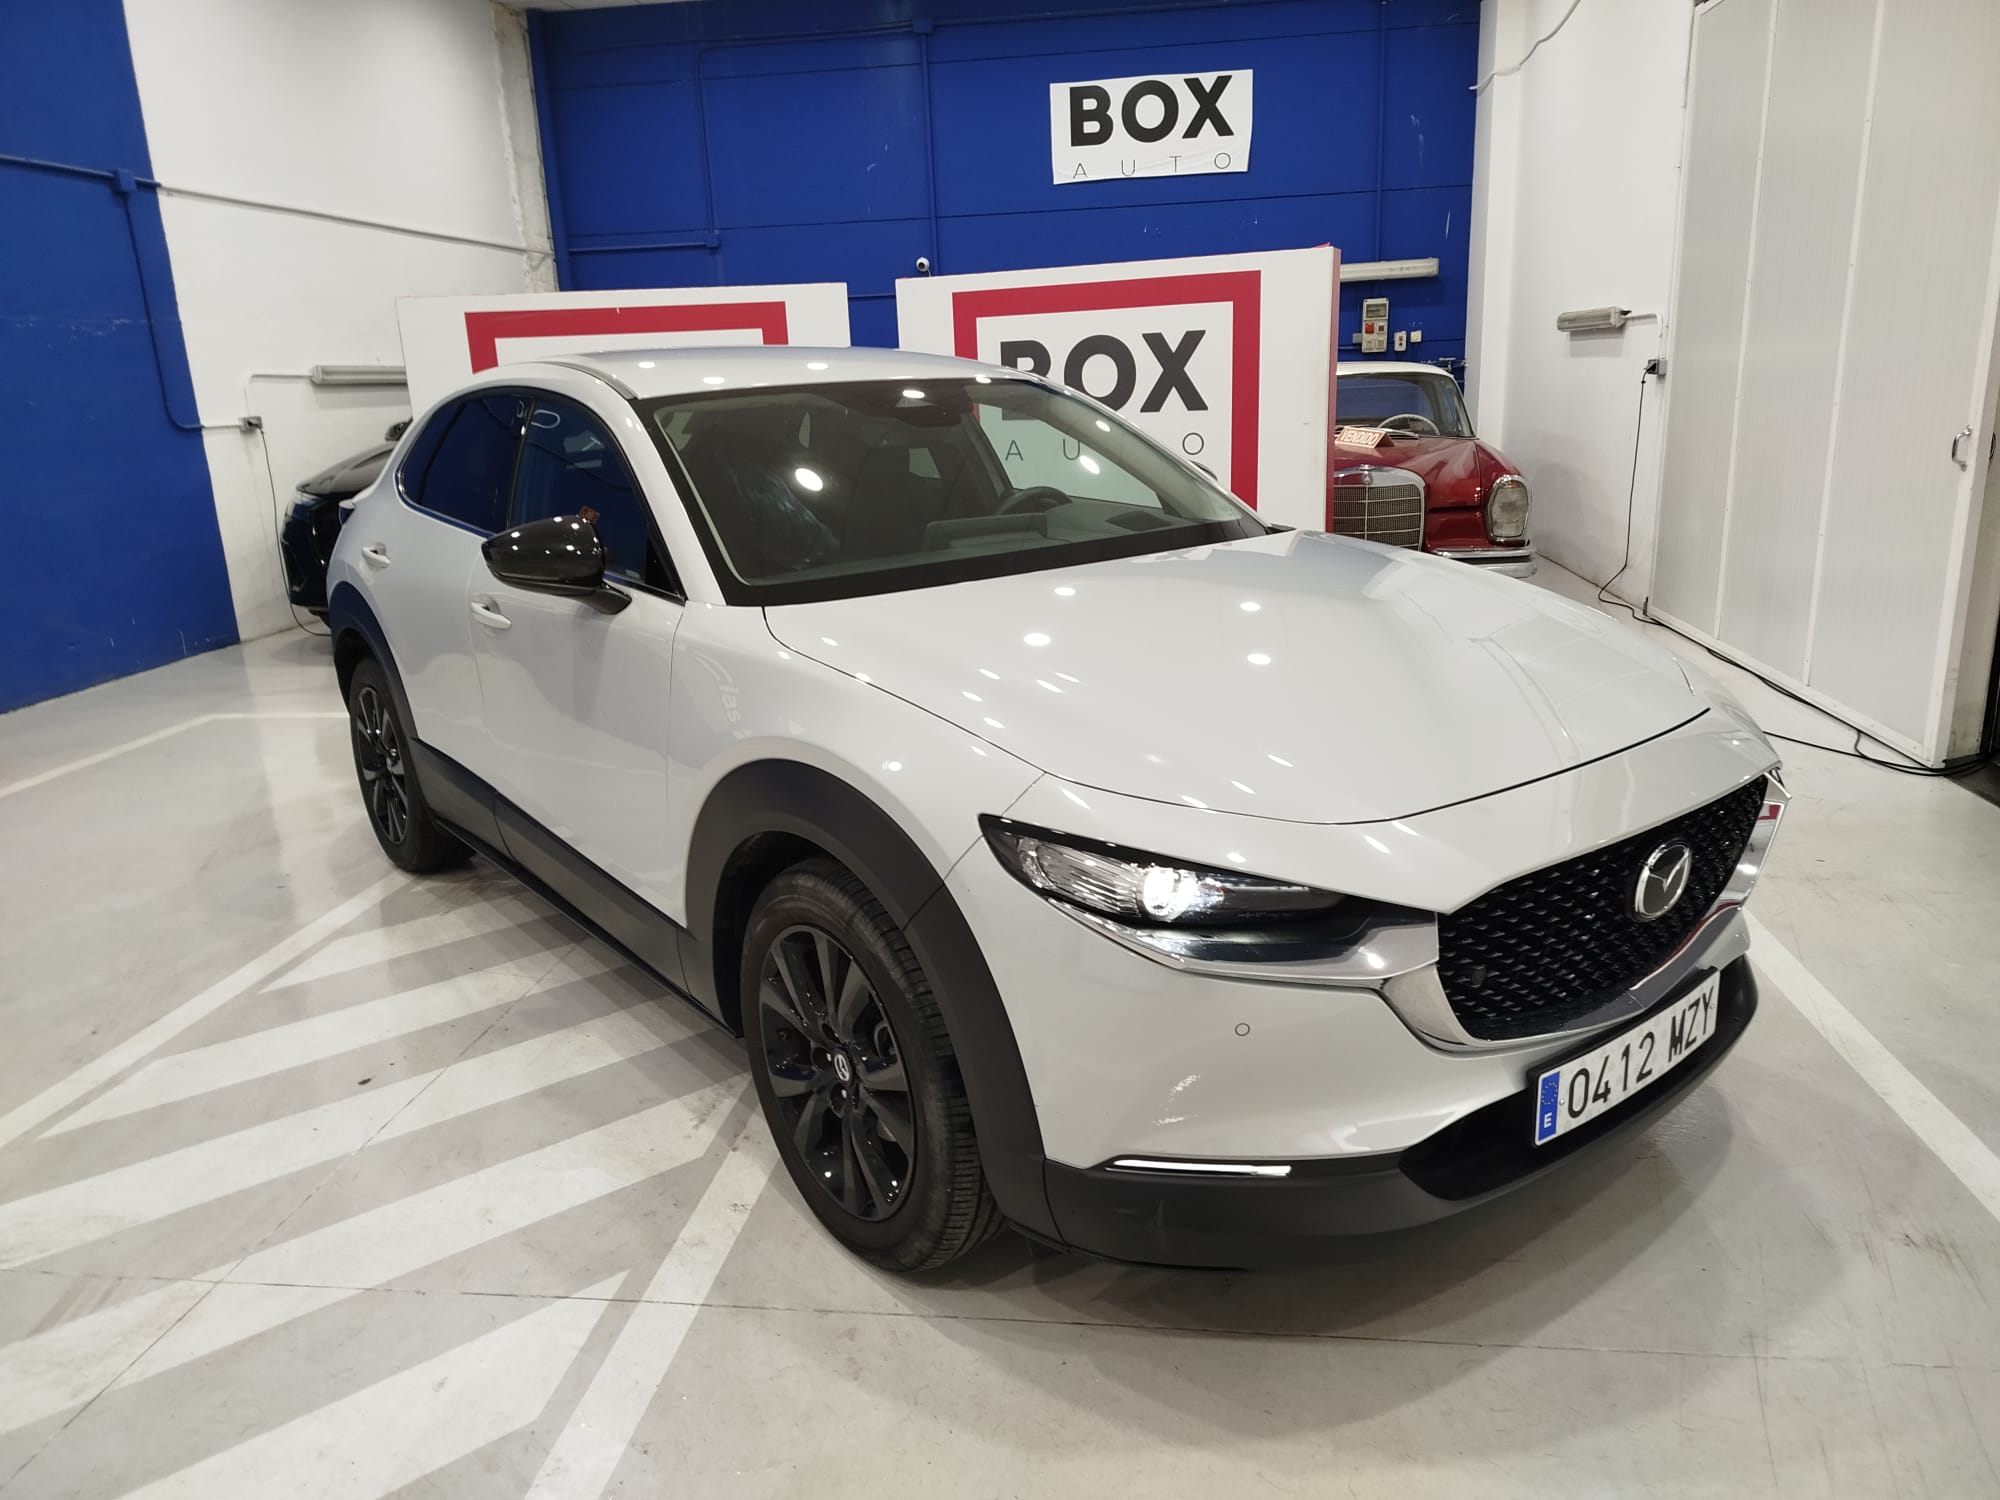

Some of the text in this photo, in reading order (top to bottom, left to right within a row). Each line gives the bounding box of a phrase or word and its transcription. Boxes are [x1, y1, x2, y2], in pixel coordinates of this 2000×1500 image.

[1069, 75, 1234, 147] BOX
[1072, 152, 1232, 179] AUTO
[1004, 432, 1205, 461] AUO
[1340, 428, 1380, 446] VENDIDO
[1567, 985, 1714, 1118] 0412 MZY
[1543, 1112, 1553, 1129] E
